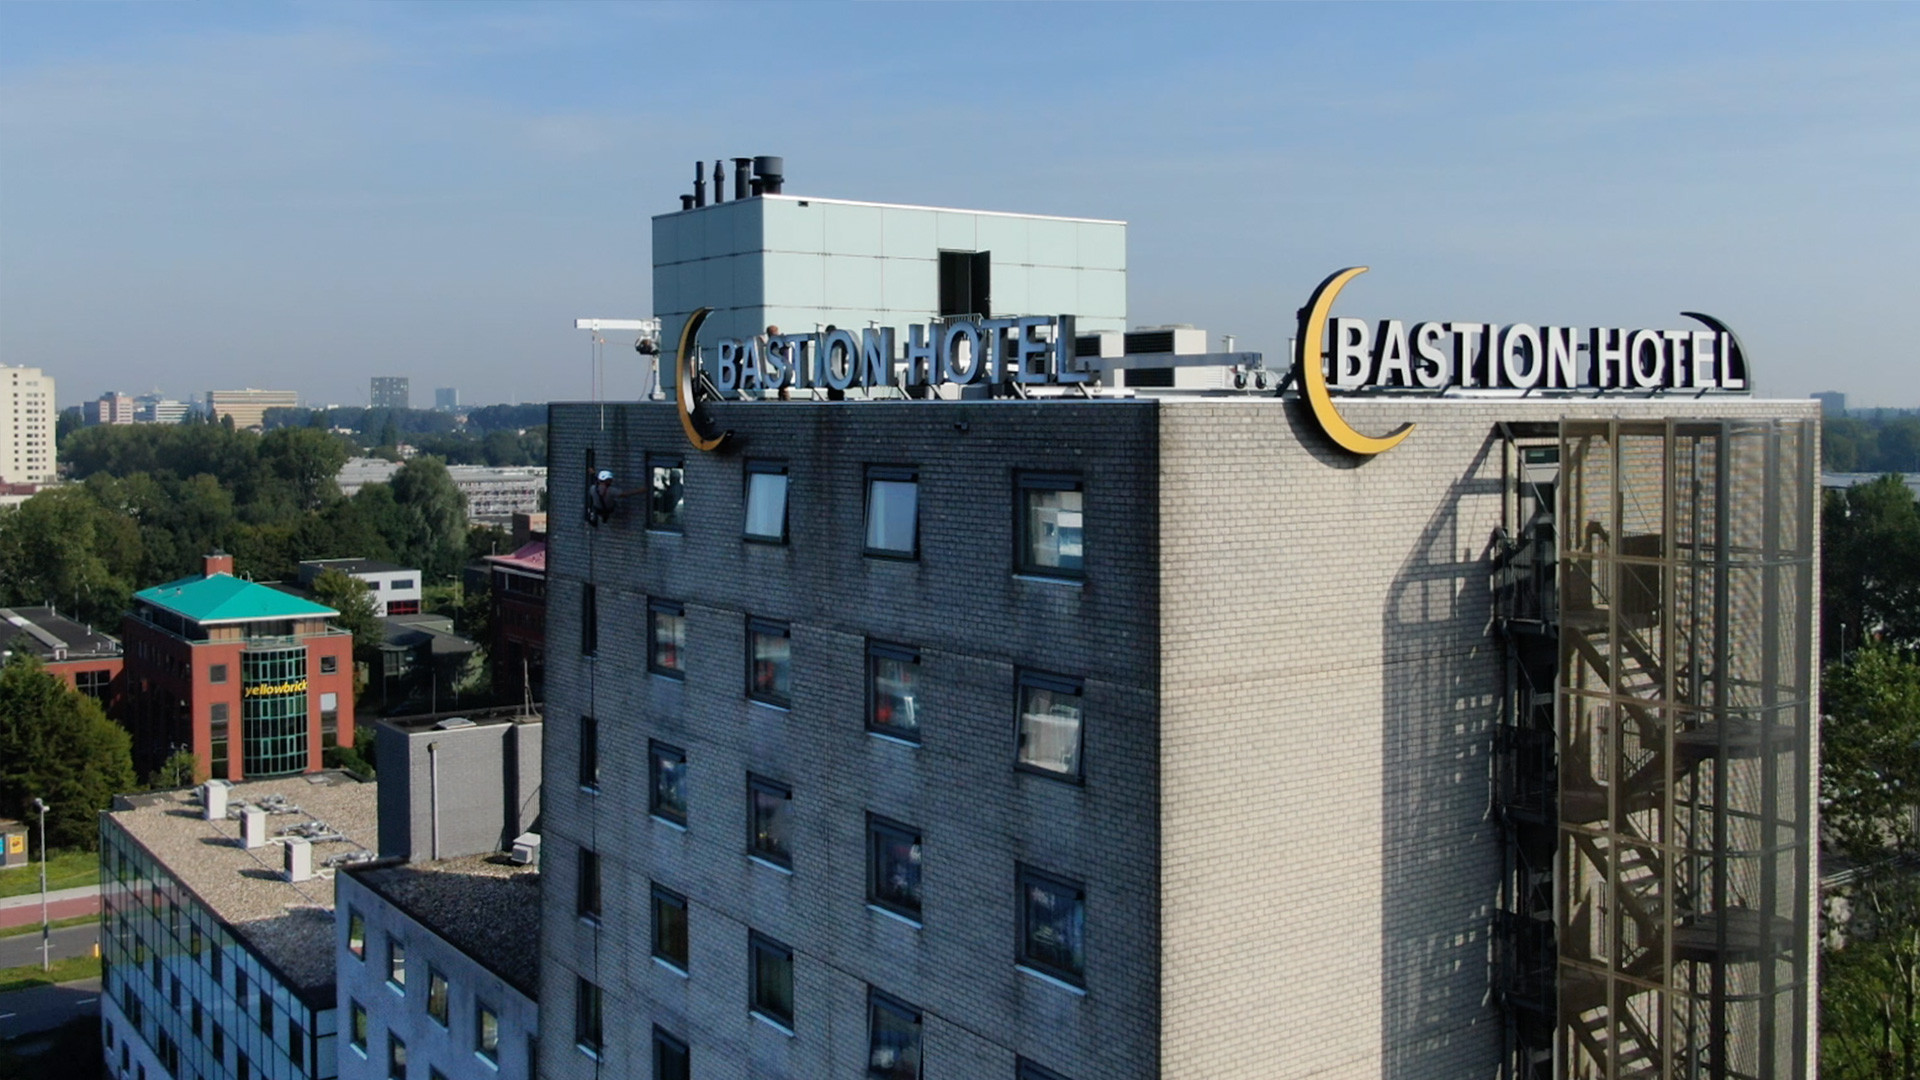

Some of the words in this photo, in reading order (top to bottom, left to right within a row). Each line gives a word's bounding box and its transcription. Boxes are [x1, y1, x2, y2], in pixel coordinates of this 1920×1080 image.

[717, 326, 895, 392] BASTION
[908, 314, 1090, 385] HOTEL
[1335, 317, 1578, 388] BASTION
[1599, 327, 1744, 389] HOTEL
[244, 680, 308, 697] yellowbrick
